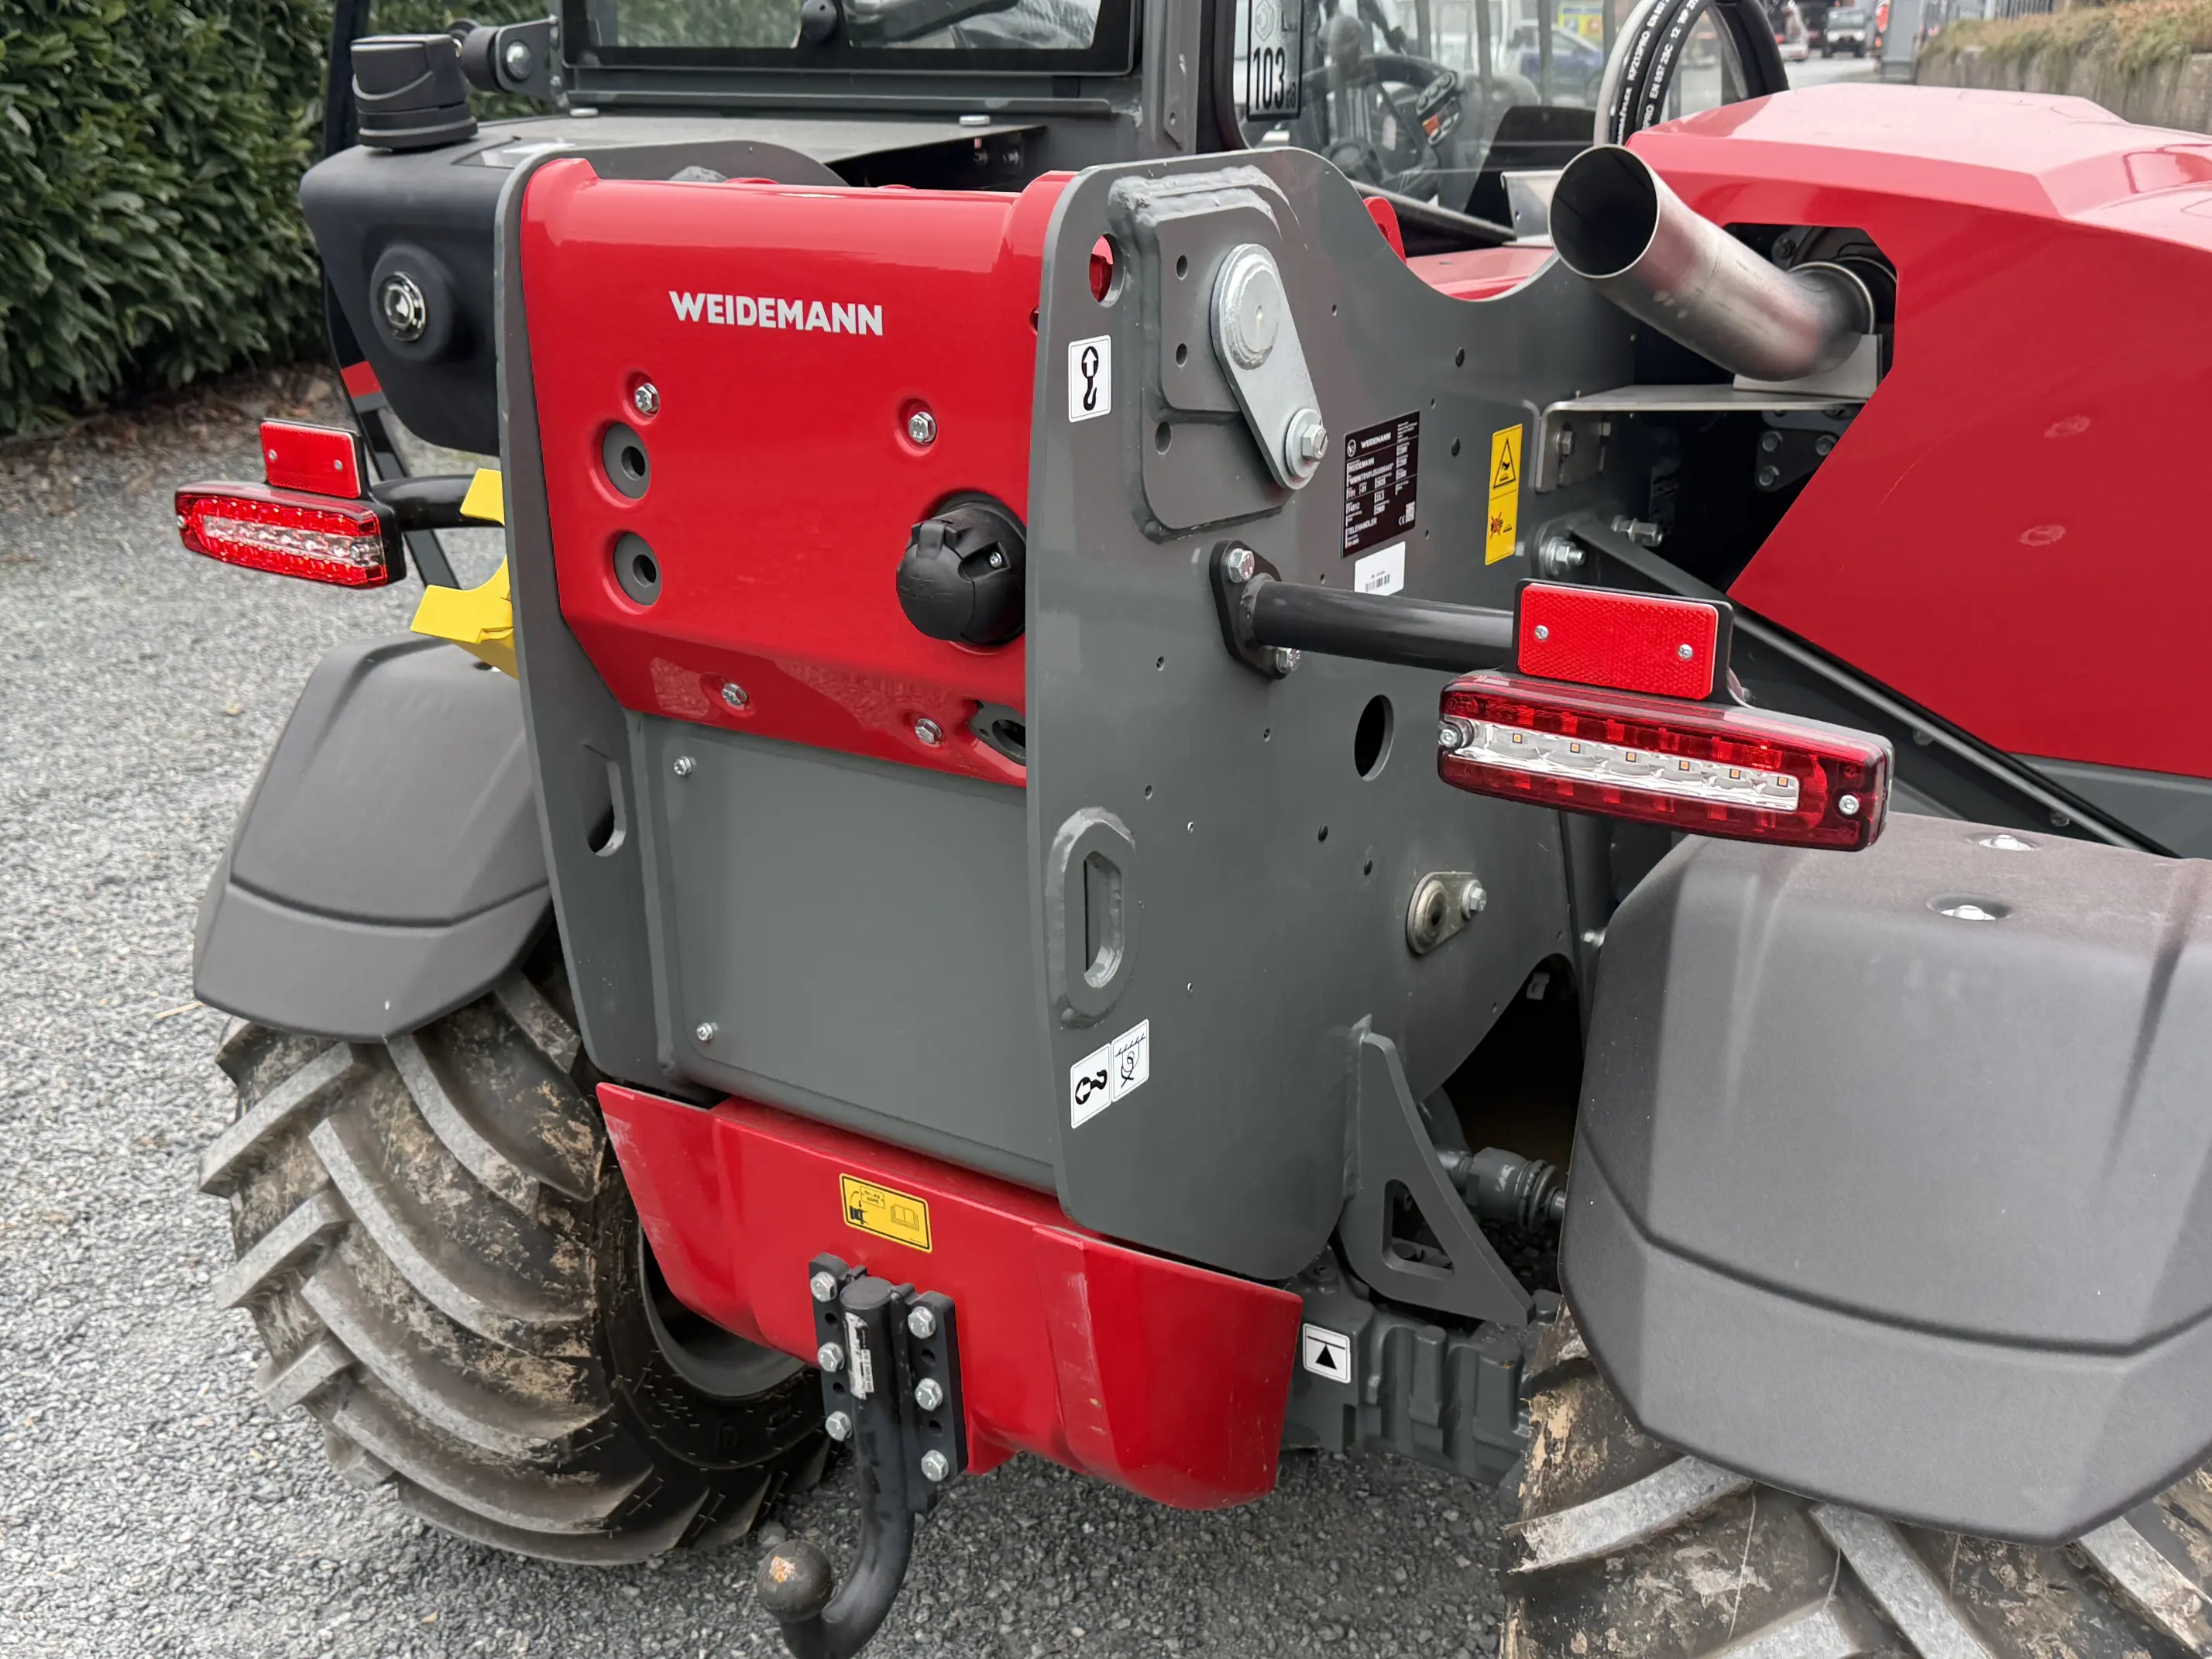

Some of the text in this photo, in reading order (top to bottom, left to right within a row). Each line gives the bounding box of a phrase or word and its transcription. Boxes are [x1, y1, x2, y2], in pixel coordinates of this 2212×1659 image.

[1647, 15, 1660, 27] EN
[1670, 26, 1681, 40] 12
[1252, 46, 1286, 110] 103
[1654, 64, 1664, 83] 857
[1649, 83, 1661, 99] EN
[668, 290, 884, 336] WEIDEMANN
[1361, 432, 1391, 448] WEIDEMANN
